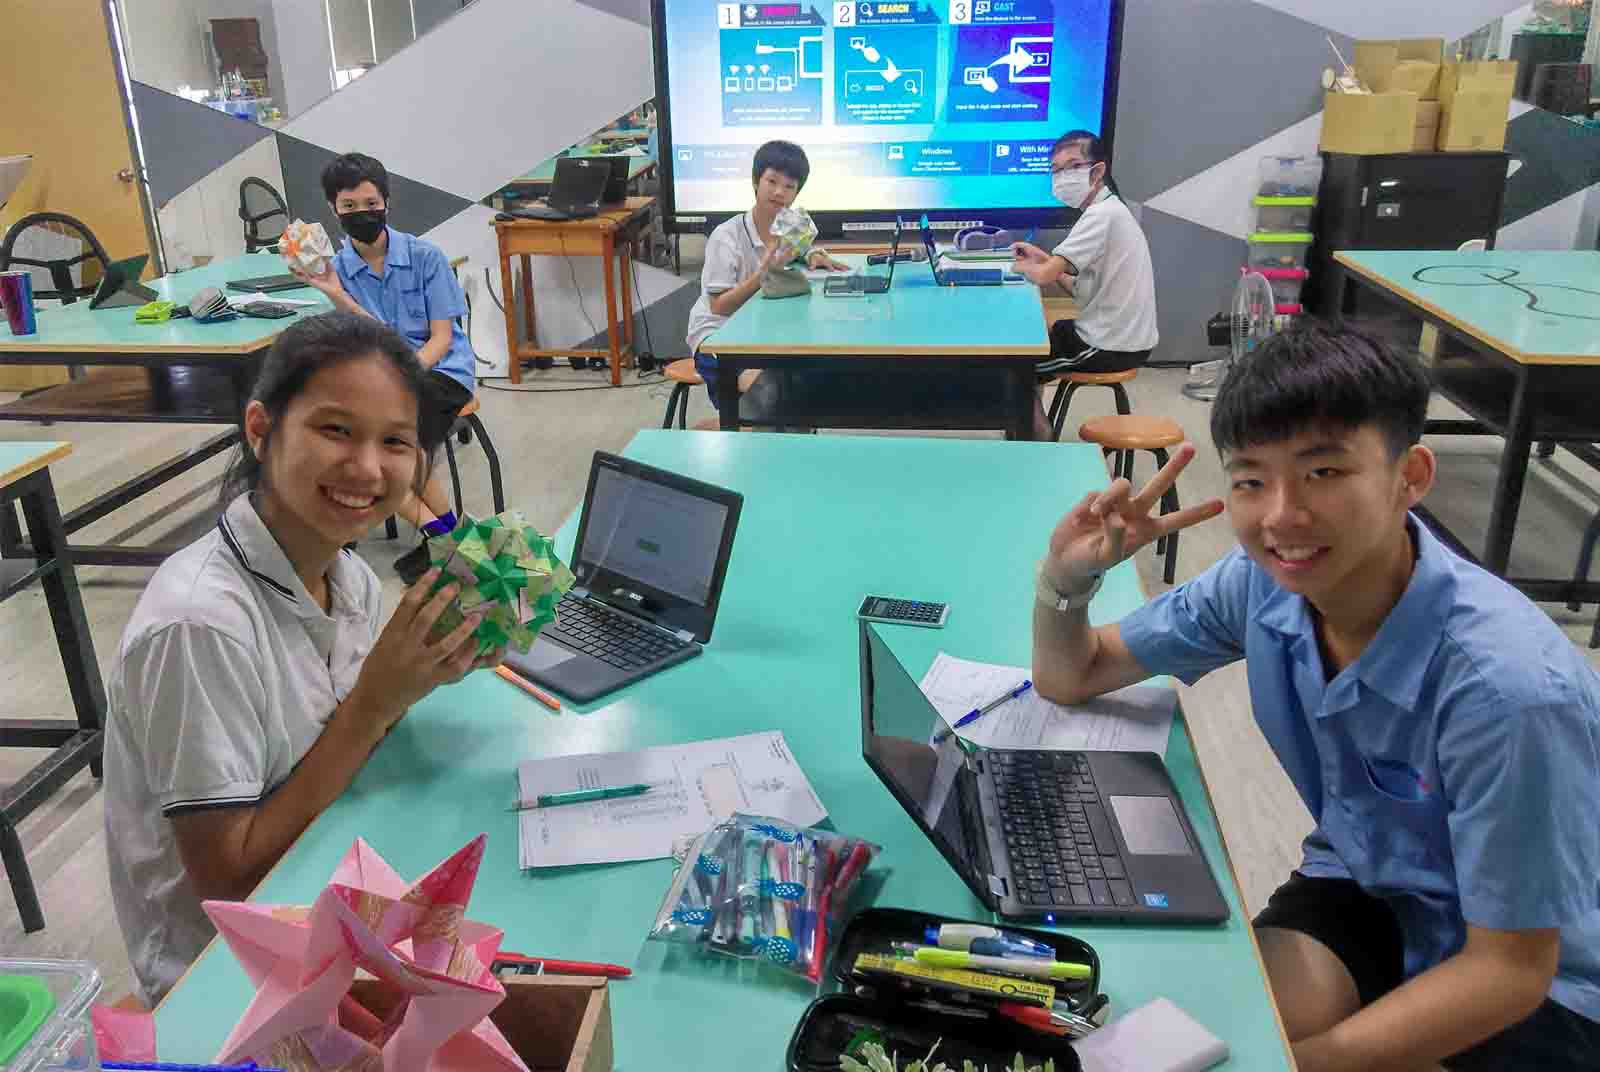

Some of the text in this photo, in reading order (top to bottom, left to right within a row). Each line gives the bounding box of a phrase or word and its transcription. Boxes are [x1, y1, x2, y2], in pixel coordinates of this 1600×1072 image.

[877, 4, 909, 14] SEARCH
[954, 2, 966, 21] 3
[993, 2, 1015, 11] CAST
[839, 5, 850, 23] 2
